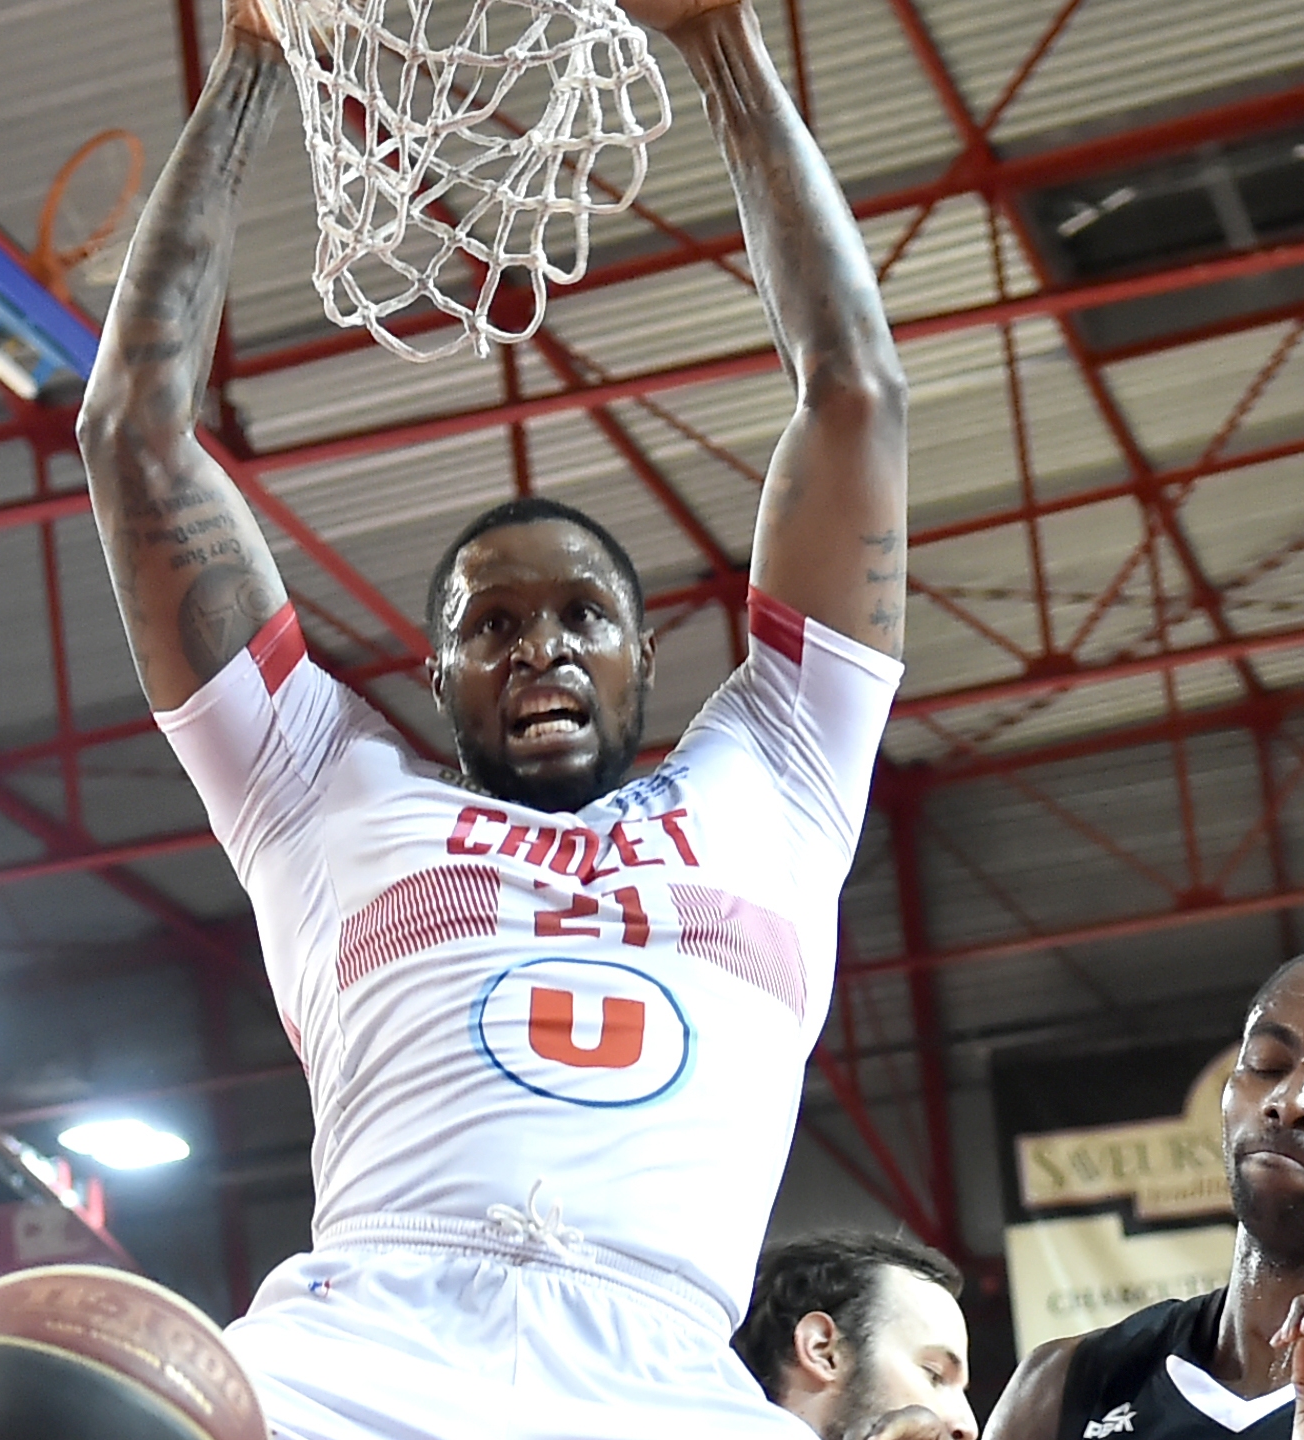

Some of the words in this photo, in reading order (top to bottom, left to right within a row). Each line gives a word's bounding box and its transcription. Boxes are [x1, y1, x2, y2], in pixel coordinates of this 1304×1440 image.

[447, 806, 700, 886] CHOLET
[534, 879, 650, 948] 21
[529, 986, 645, 1068] U
